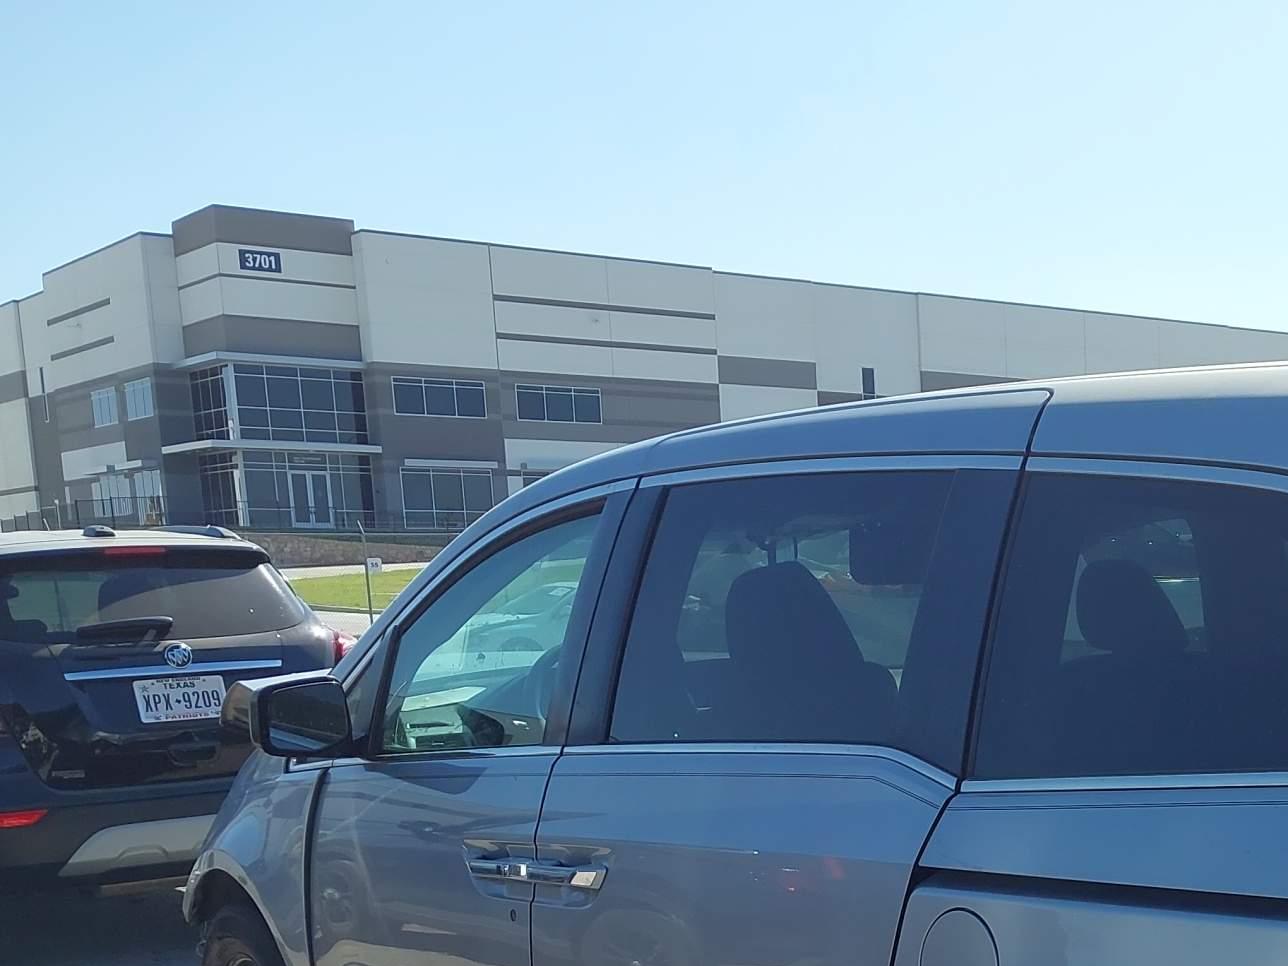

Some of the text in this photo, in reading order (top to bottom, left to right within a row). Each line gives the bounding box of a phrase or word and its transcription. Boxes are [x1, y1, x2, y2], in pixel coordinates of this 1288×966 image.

[245, 253, 276, 269] 3701
[163, 681, 196, 690] TEXAS
[142, 690, 221, 712] XPX 9209
